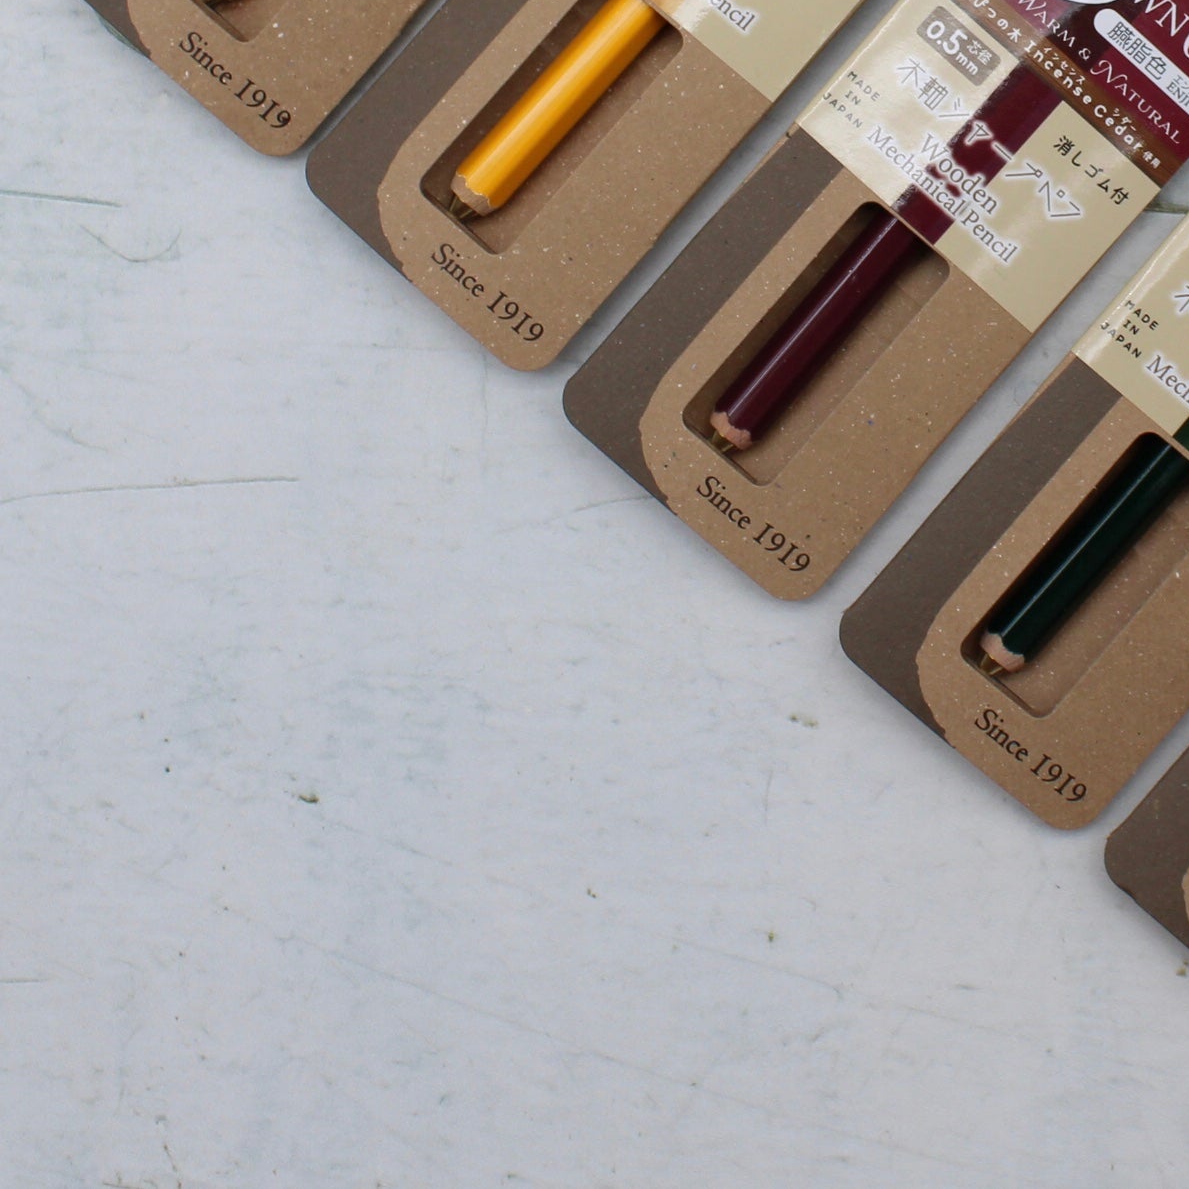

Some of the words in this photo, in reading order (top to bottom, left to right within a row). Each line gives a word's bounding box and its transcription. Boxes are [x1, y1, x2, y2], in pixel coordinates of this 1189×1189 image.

[177, 32, 232, 85] Since
[232, 76, 293, 128] 1919
[821, 90, 864, 130] JAPAN
[843, 88, 862, 107] IN
[845, 69, 881, 103] MADE
[1022, 38, 1093, 106] Incense
[1094, 105, 1142, 150] Cedar
[1077, 46, 1090, 62] &
[1089, 60, 1179, 144] NATURAL
[895, 56, 1080, 218] 木軸シャープペン
[920, 132, 999, 216] Wooden
[1052, 134, 1130, 205] 消しゴム付
[865, 123, 966, 217] Mechanical
[959, 207, 1017, 263] Pencil
[431, 246, 483, 297] Since
[485, 288, 545, 341] 1919
[1121, 318, 1141, 337] IN
[1122, 298, 1160, 332] MADE
[1099, 320, 1143, 359] JAPAN
[696, 478, 749, 529] Since
[752, 521, 810, 571] 1919
[974, 710, 1027, 760] Since
[1029, 752, 1088, 803] 1919
